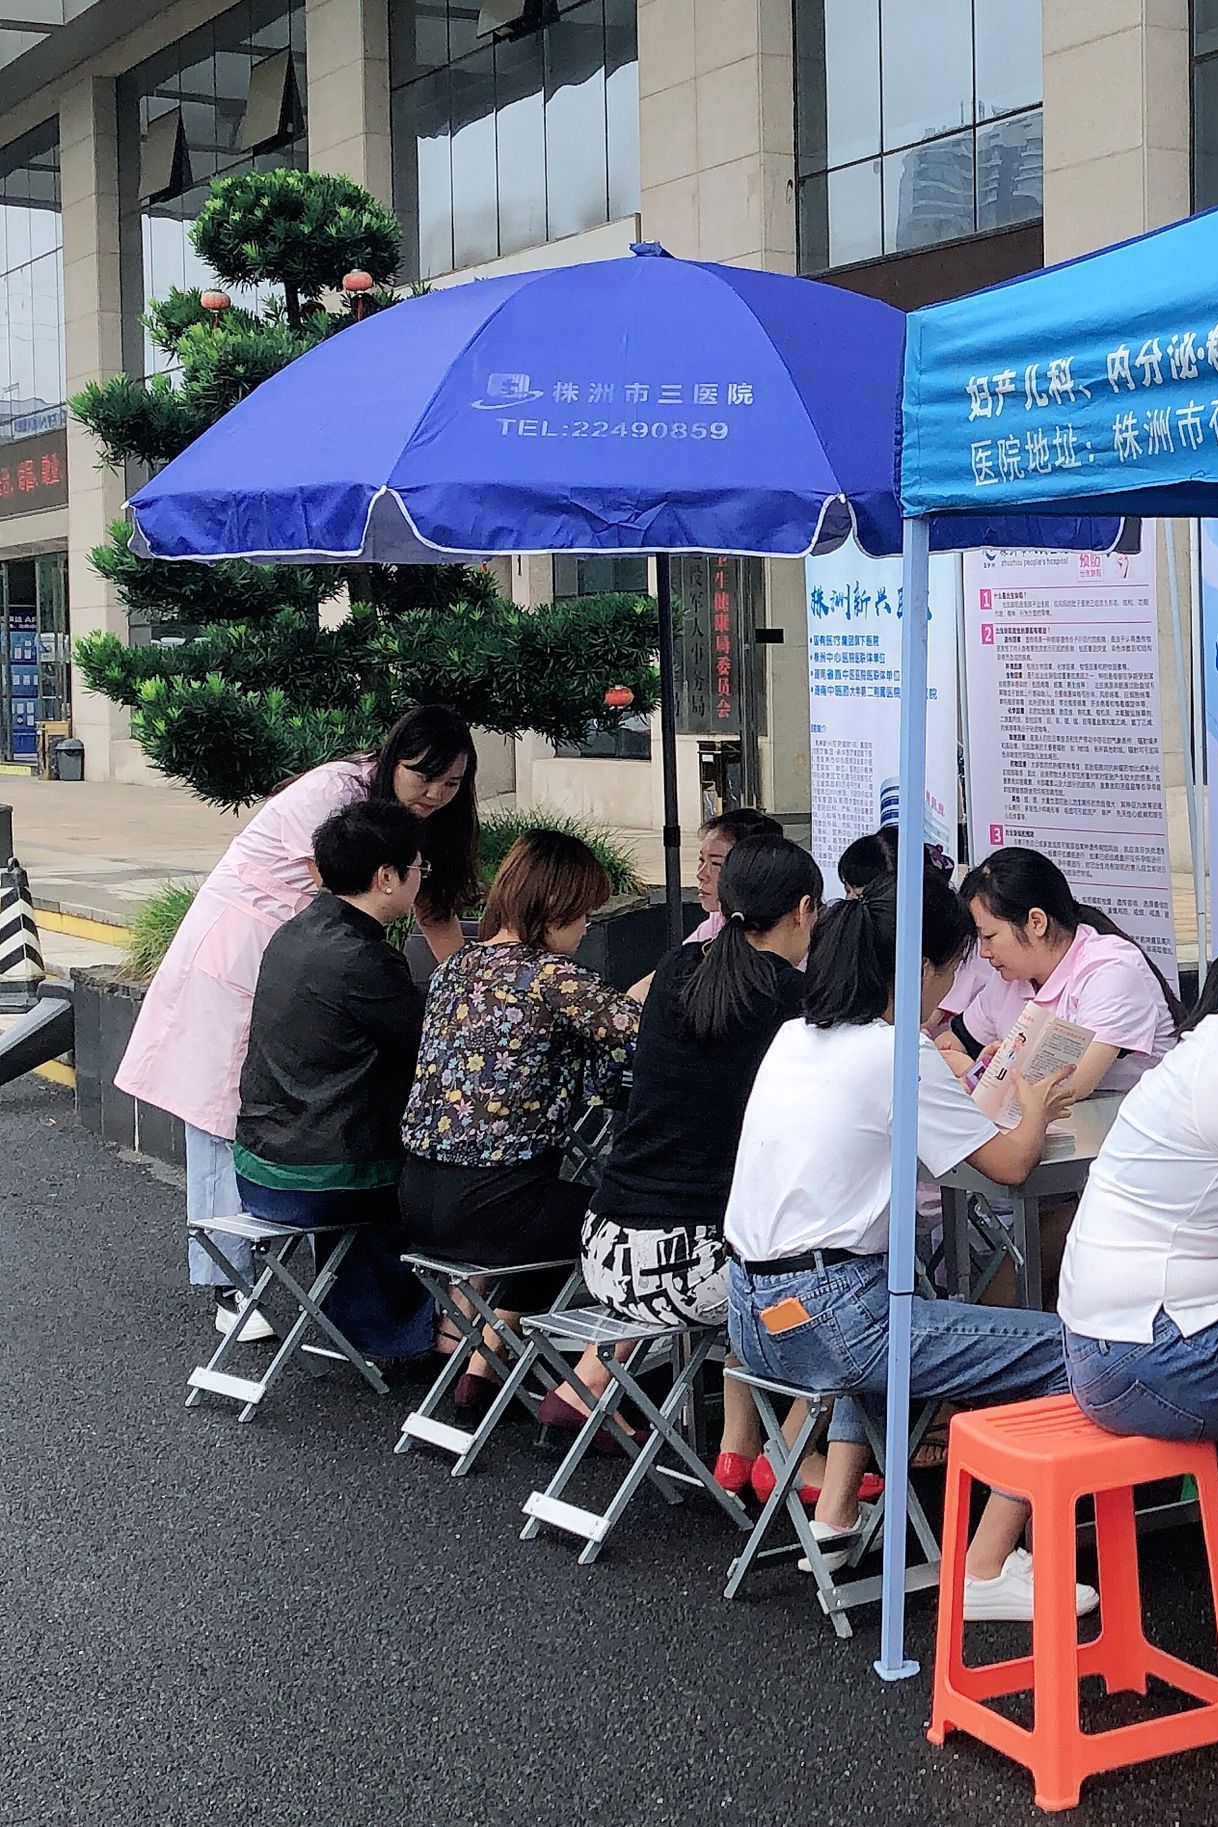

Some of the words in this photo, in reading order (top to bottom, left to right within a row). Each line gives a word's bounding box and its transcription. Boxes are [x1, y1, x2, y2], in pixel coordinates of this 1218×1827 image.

[552, 381, 754, 405] 株洲市三医院
[496, 418, 729, 440] TEL:22490859
[810, 580, 932, 621] 株洲新兴
